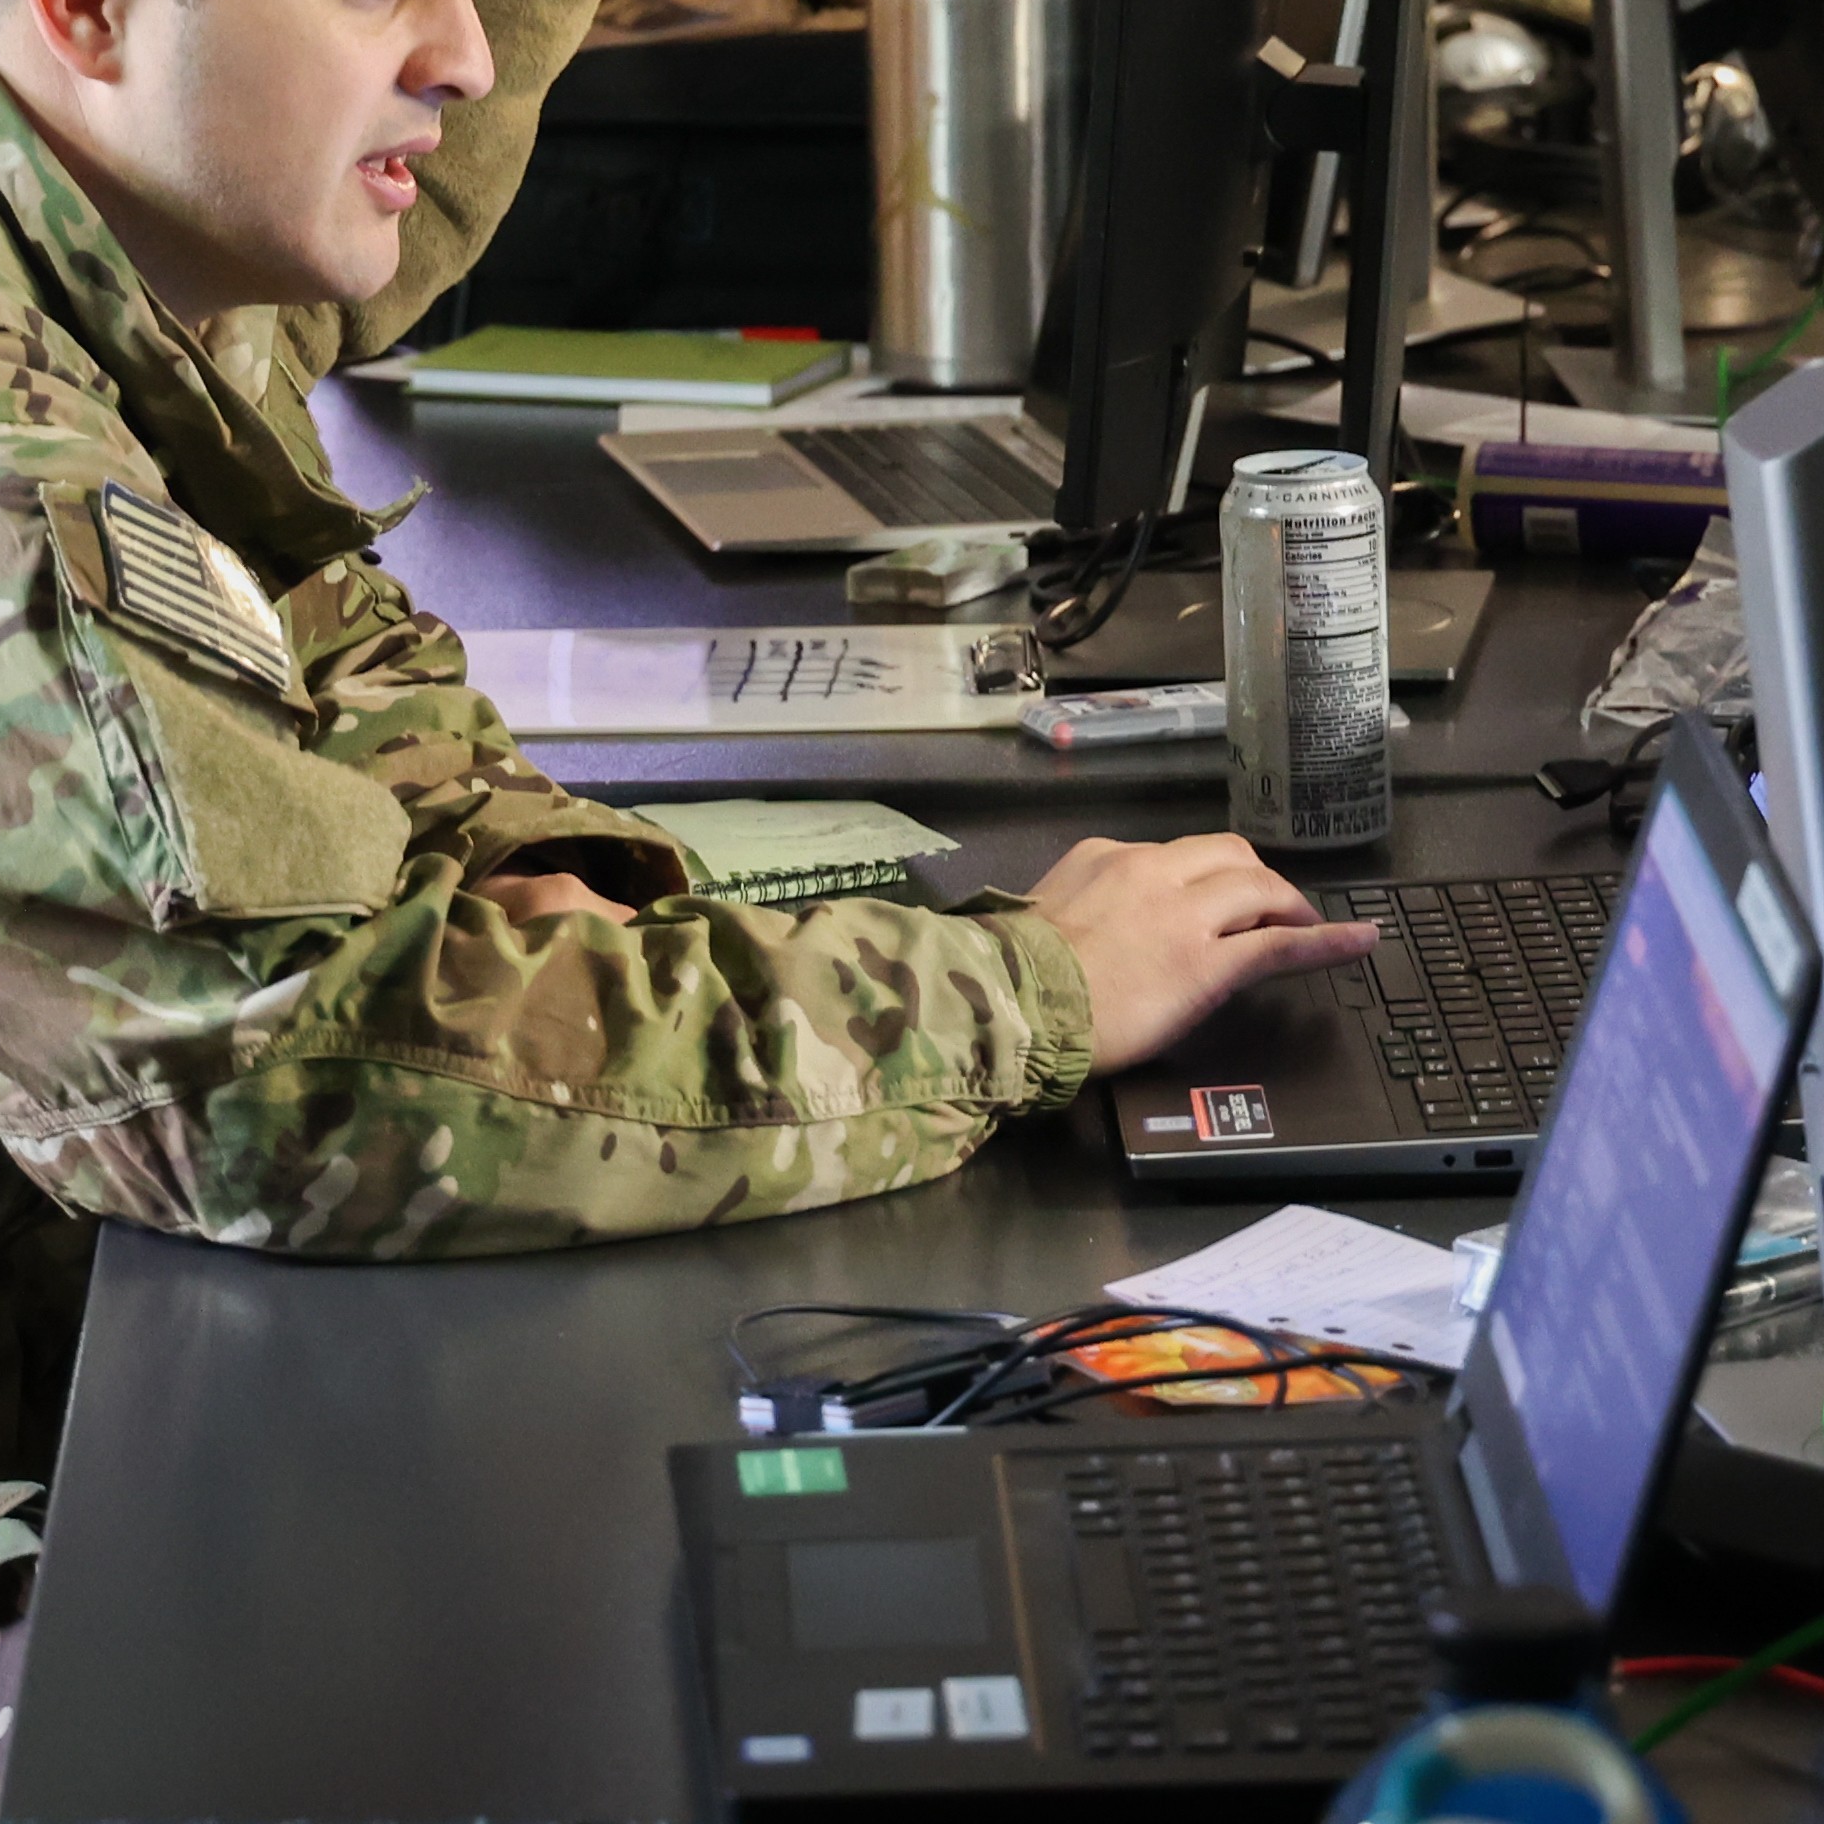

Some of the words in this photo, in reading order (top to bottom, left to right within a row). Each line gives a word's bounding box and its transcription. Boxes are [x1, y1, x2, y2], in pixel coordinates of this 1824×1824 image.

[1285, 516, 1346, 529] Nutrition
[1351, 509, 1376, 524] Facts
[1285, 551, 1323, 561] Calories
[1292, 812, 1307, 837] CA
[1309, 811, 1330, 837] CRV
